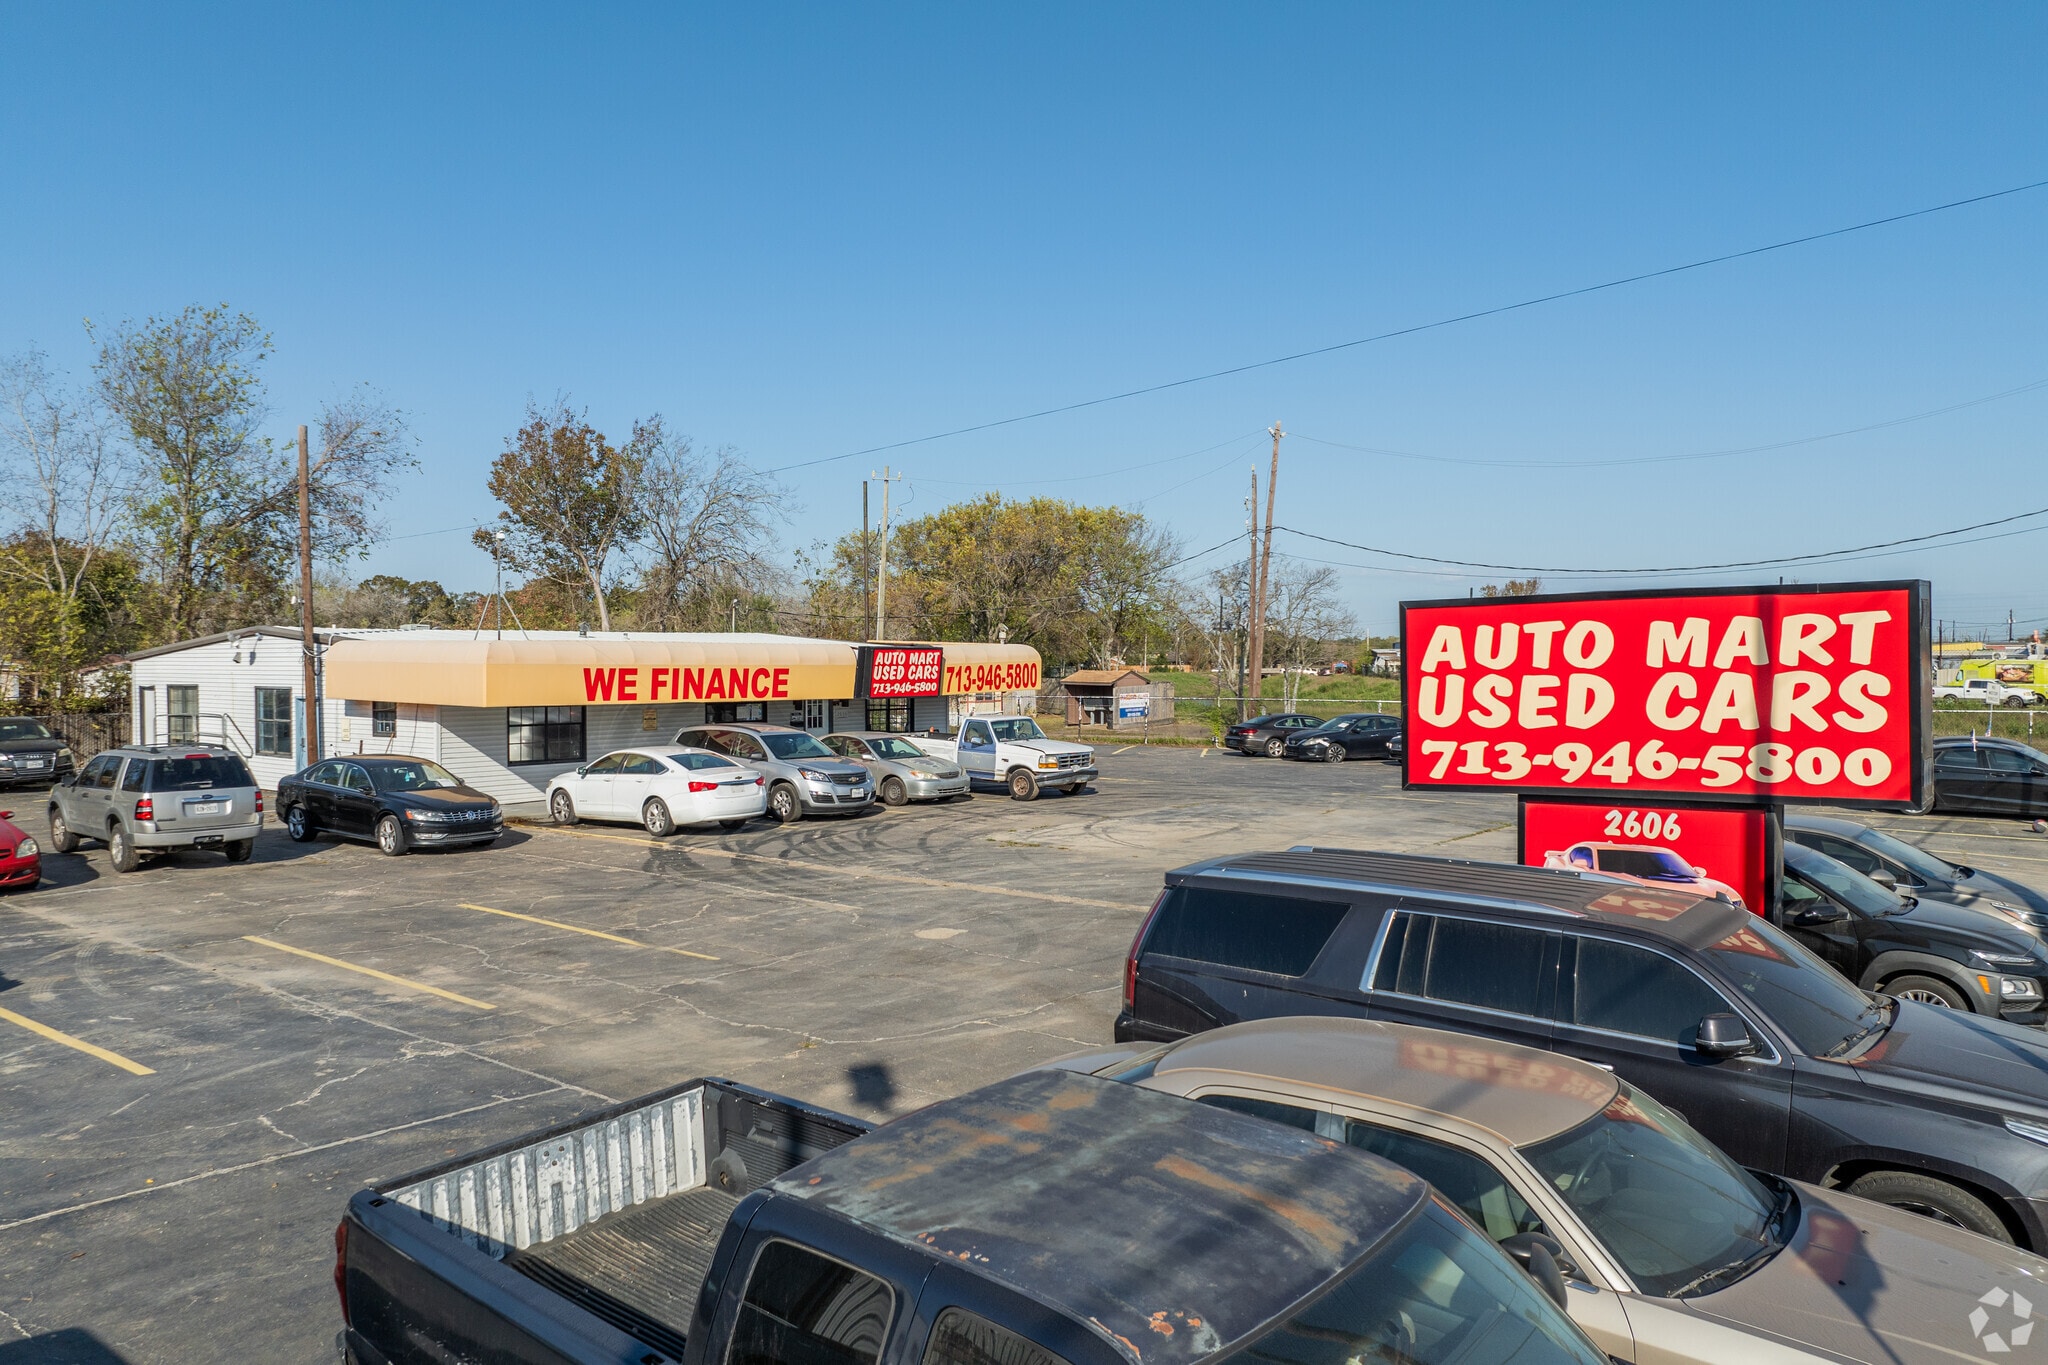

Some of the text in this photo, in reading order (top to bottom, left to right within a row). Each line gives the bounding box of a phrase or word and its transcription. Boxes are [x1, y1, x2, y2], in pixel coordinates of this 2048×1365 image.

[1420, 610, 1893, 673] AUTO MART
[873, 665, 939, 681] USED CARS
[875, 651, 941, 666] AUTO MART
[583, 667, 790, 702] WE FINANCE
[872, 681, 937, 695] 713-946-5800
[946, 662, 1038, 693] 713-946-5800
[1417, 670, 1893, 734] USED CARS
[1420, 738, 1893, 788] 713-946-5800
[1603, 809, 1682, 842] 2606
